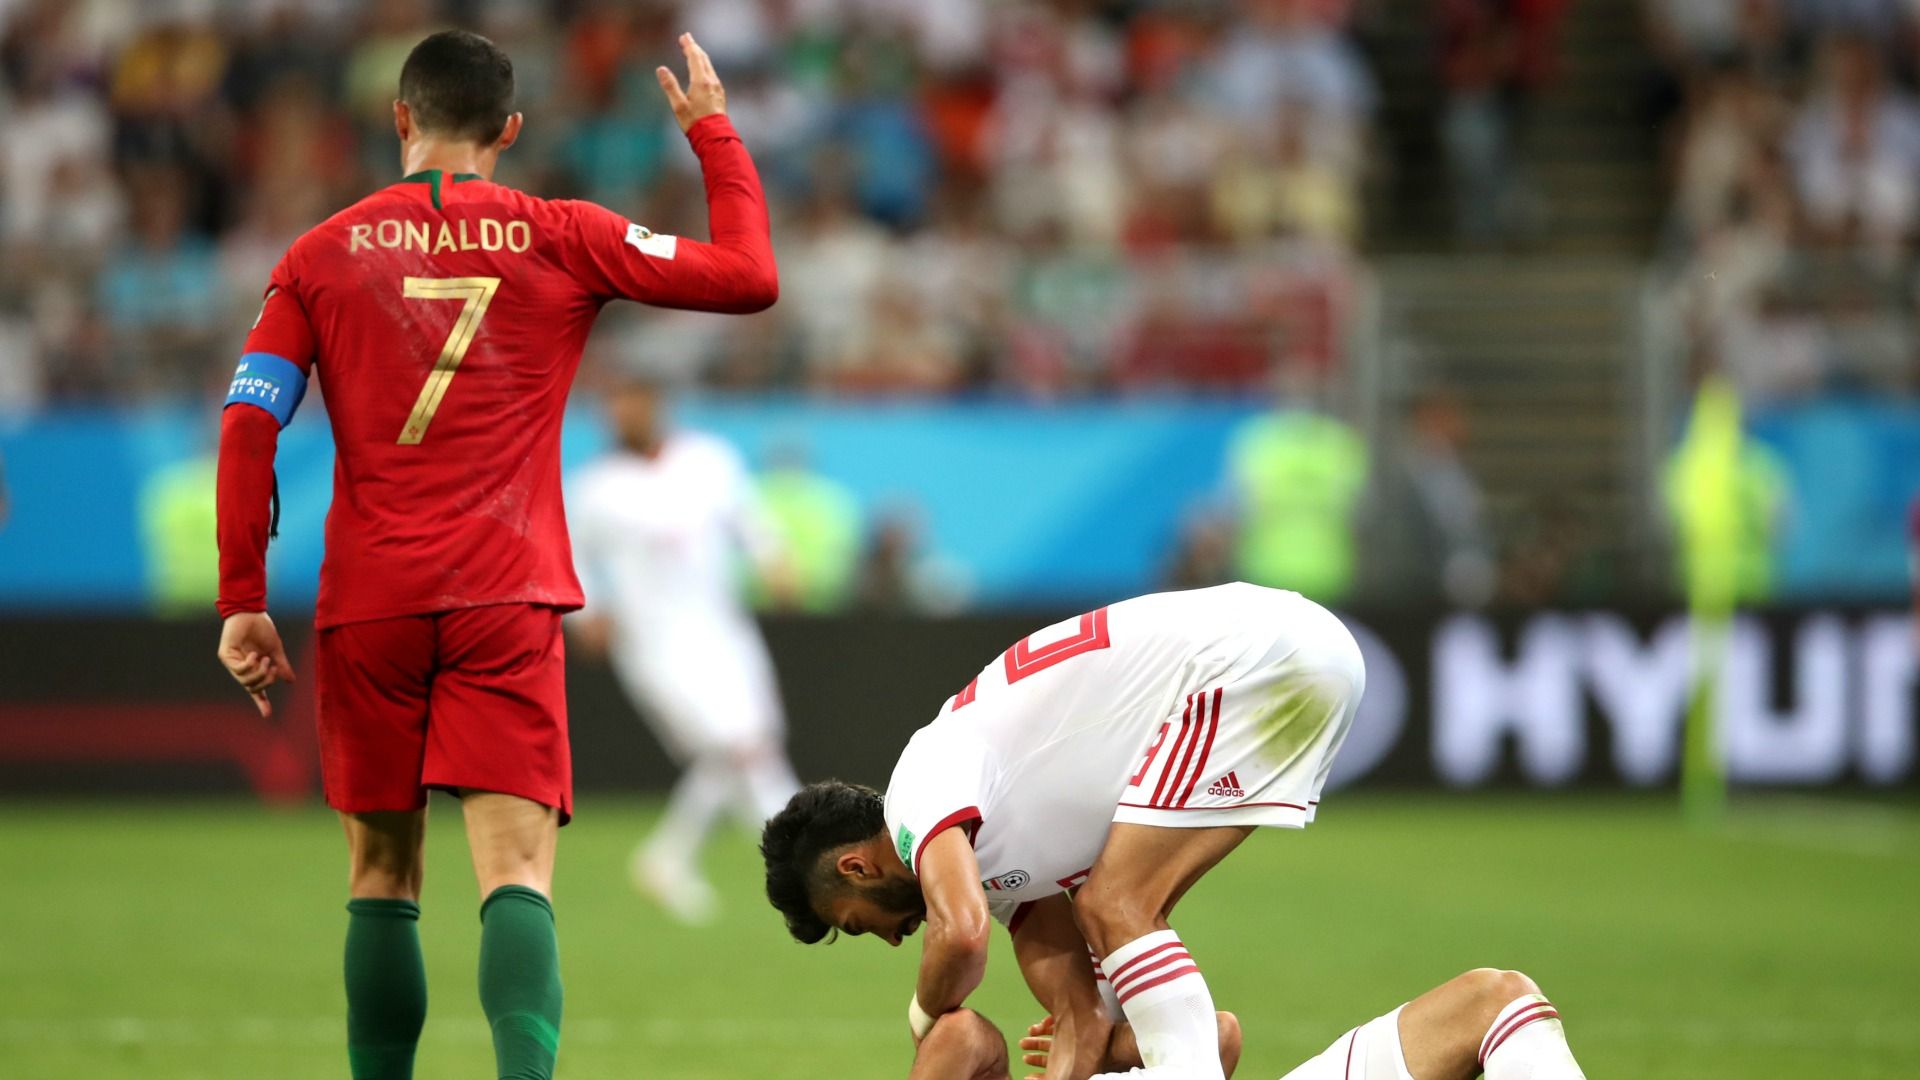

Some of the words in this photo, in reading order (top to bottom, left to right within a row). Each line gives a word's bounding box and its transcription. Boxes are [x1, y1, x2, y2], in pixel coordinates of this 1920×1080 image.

[350, 218, 531, 254] RONALDO
[396, 276, 501, 445] 7
[1207, 785, 1245, 798] adidas
